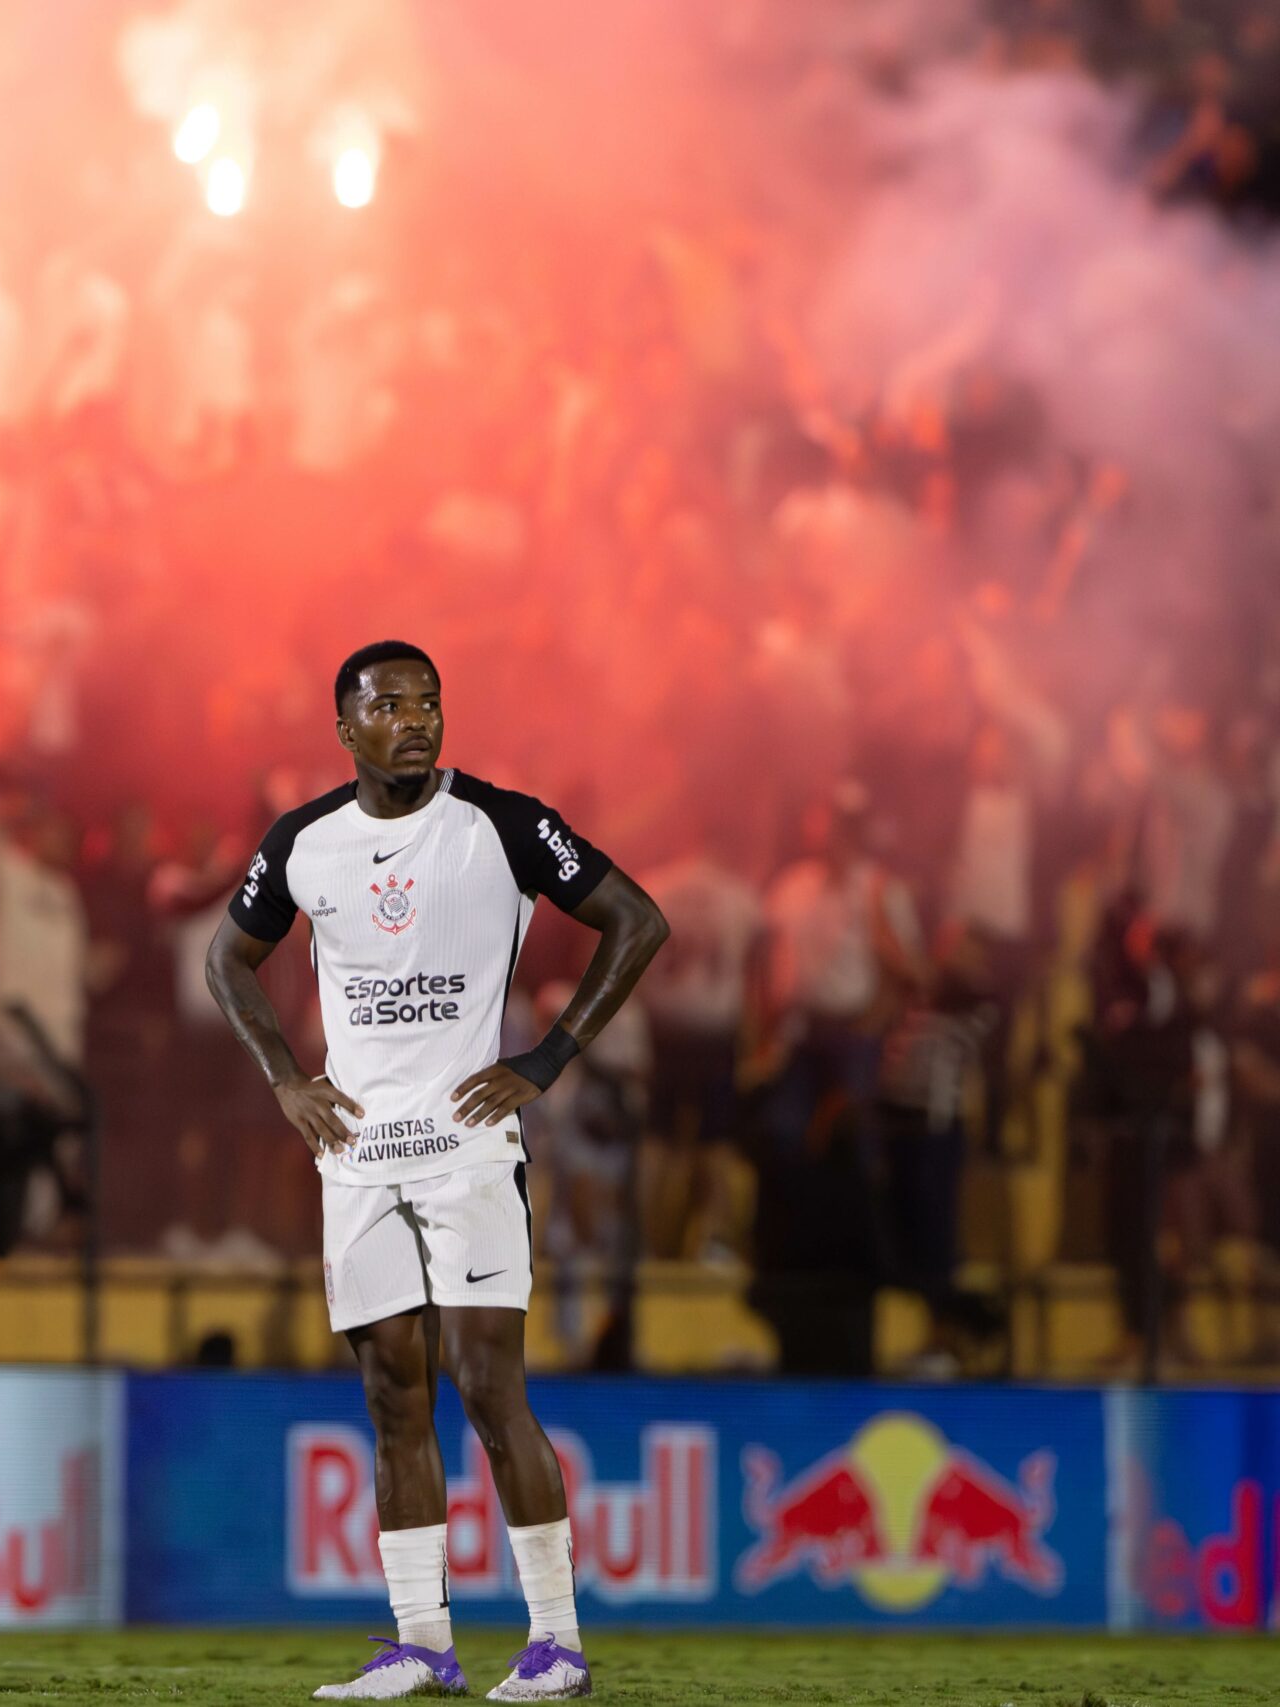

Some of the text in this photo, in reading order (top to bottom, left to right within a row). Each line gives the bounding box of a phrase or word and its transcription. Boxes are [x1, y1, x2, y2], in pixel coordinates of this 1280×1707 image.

[547, 829, 581, 881] bmg
[344, 971, 466, 1004] Esportes
[349, 998, 460, 1026] da Sorte
[361, 1117, 436, 1143] AUTISTAS
[358, 1133, 460, 1163] ALVINEGROS
[296, 1432, 712, 1588] Rd ull
